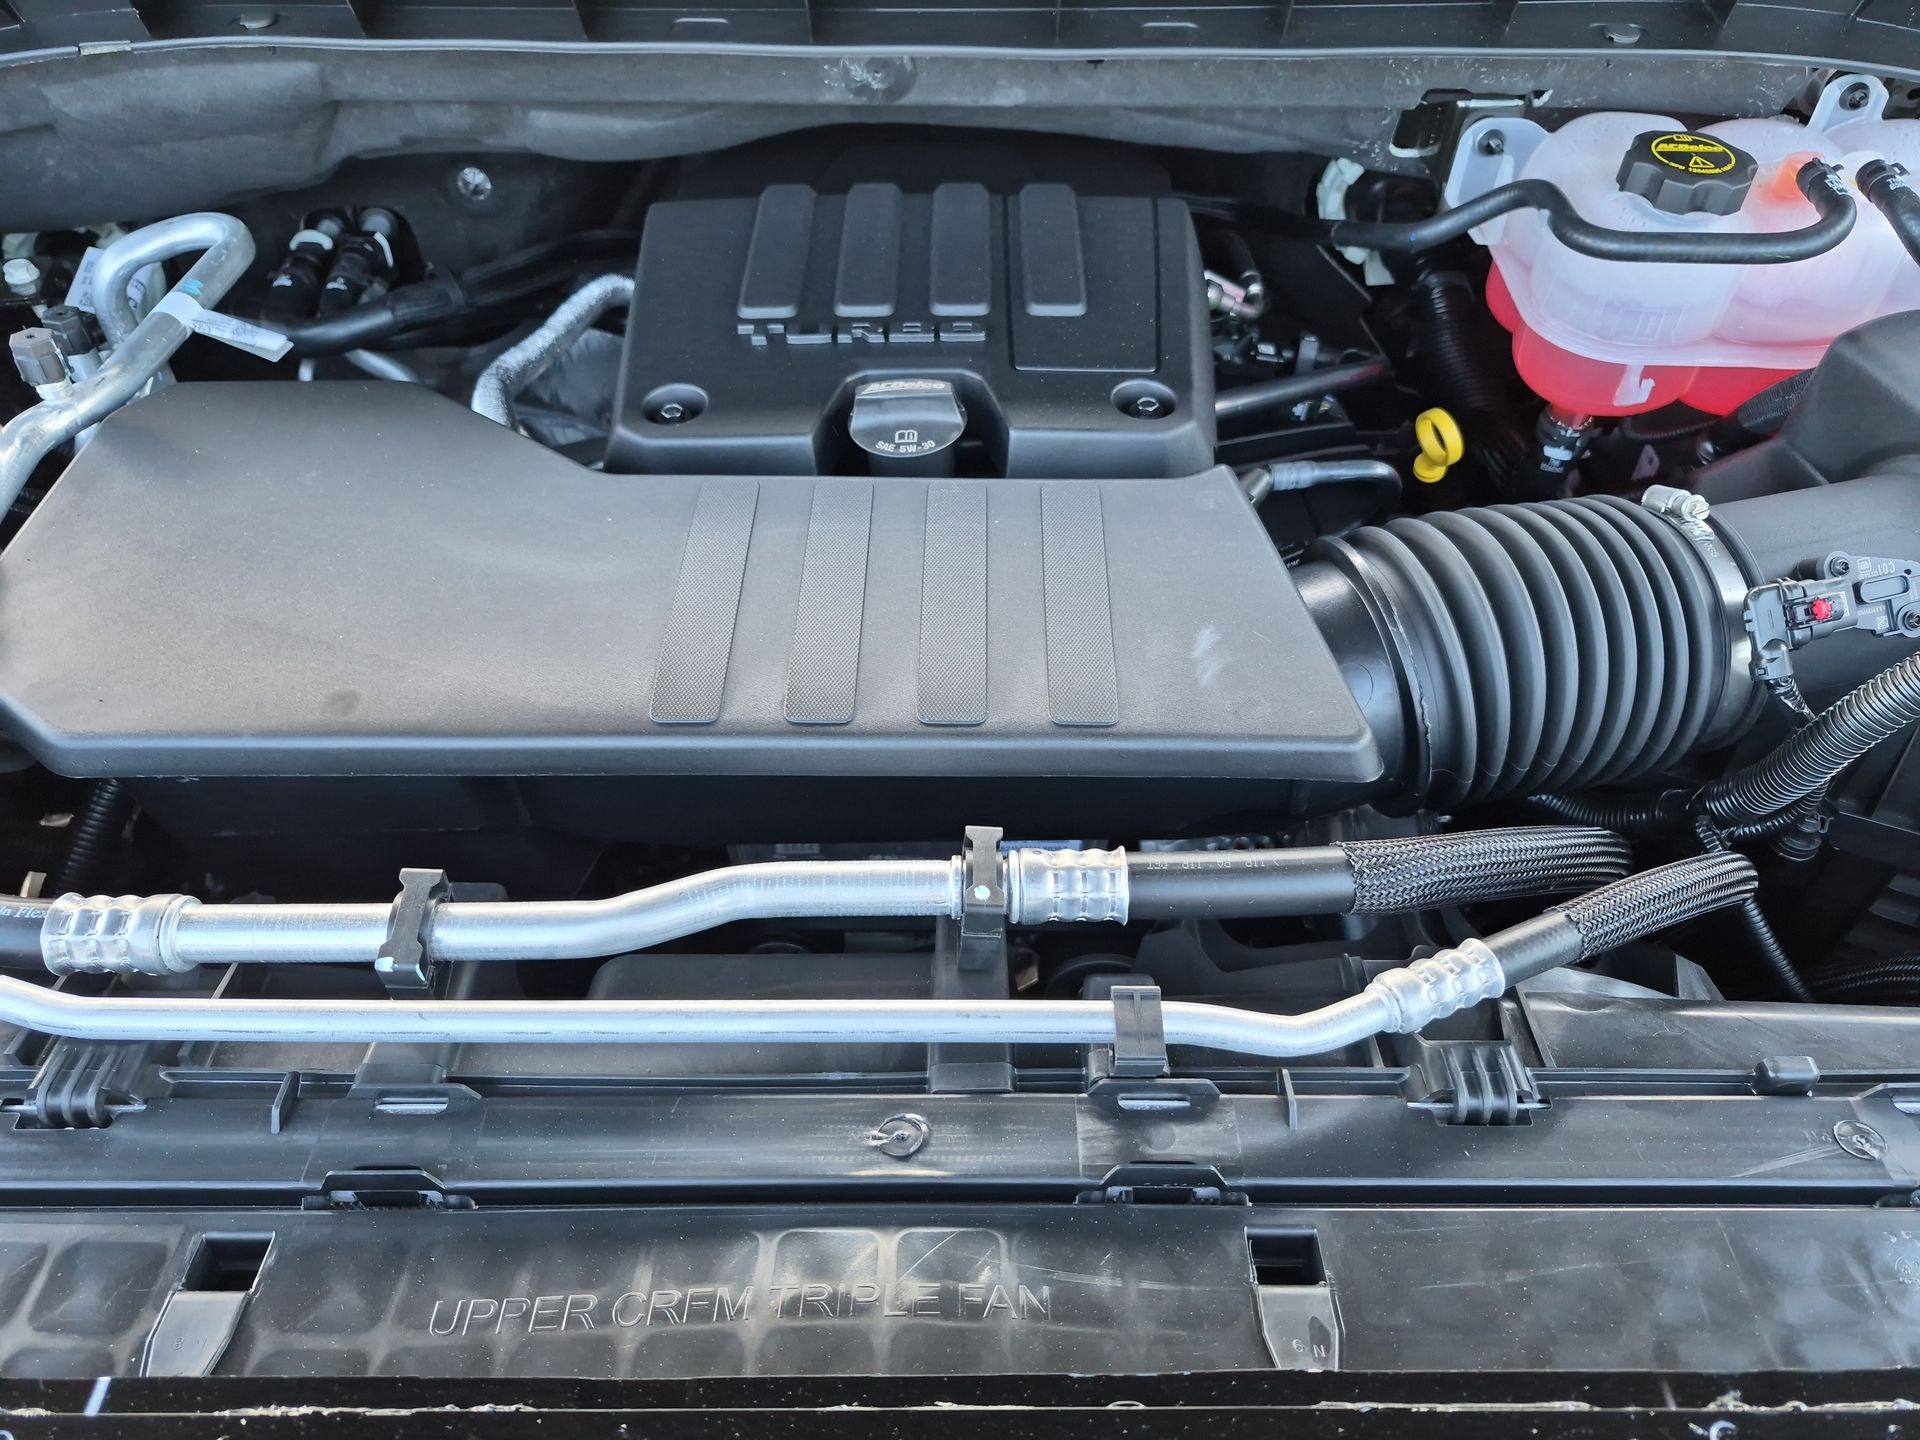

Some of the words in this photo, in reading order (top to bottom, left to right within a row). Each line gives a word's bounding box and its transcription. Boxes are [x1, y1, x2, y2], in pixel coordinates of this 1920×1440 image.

[1656, 143, 1724, 152] ACDelco
[862, 379, 946, 394] ACDelco
[875, 440, 896, 453] SAE
[899, 440, 936, 453] 5W-30
[429, 1293, 598, 1336] UPPER
[612, 1286, 754, 1328] CRFM
[769, 1282, 941, 1319] TRIPLE
[958, 1282, 1050, 1321] FAN
